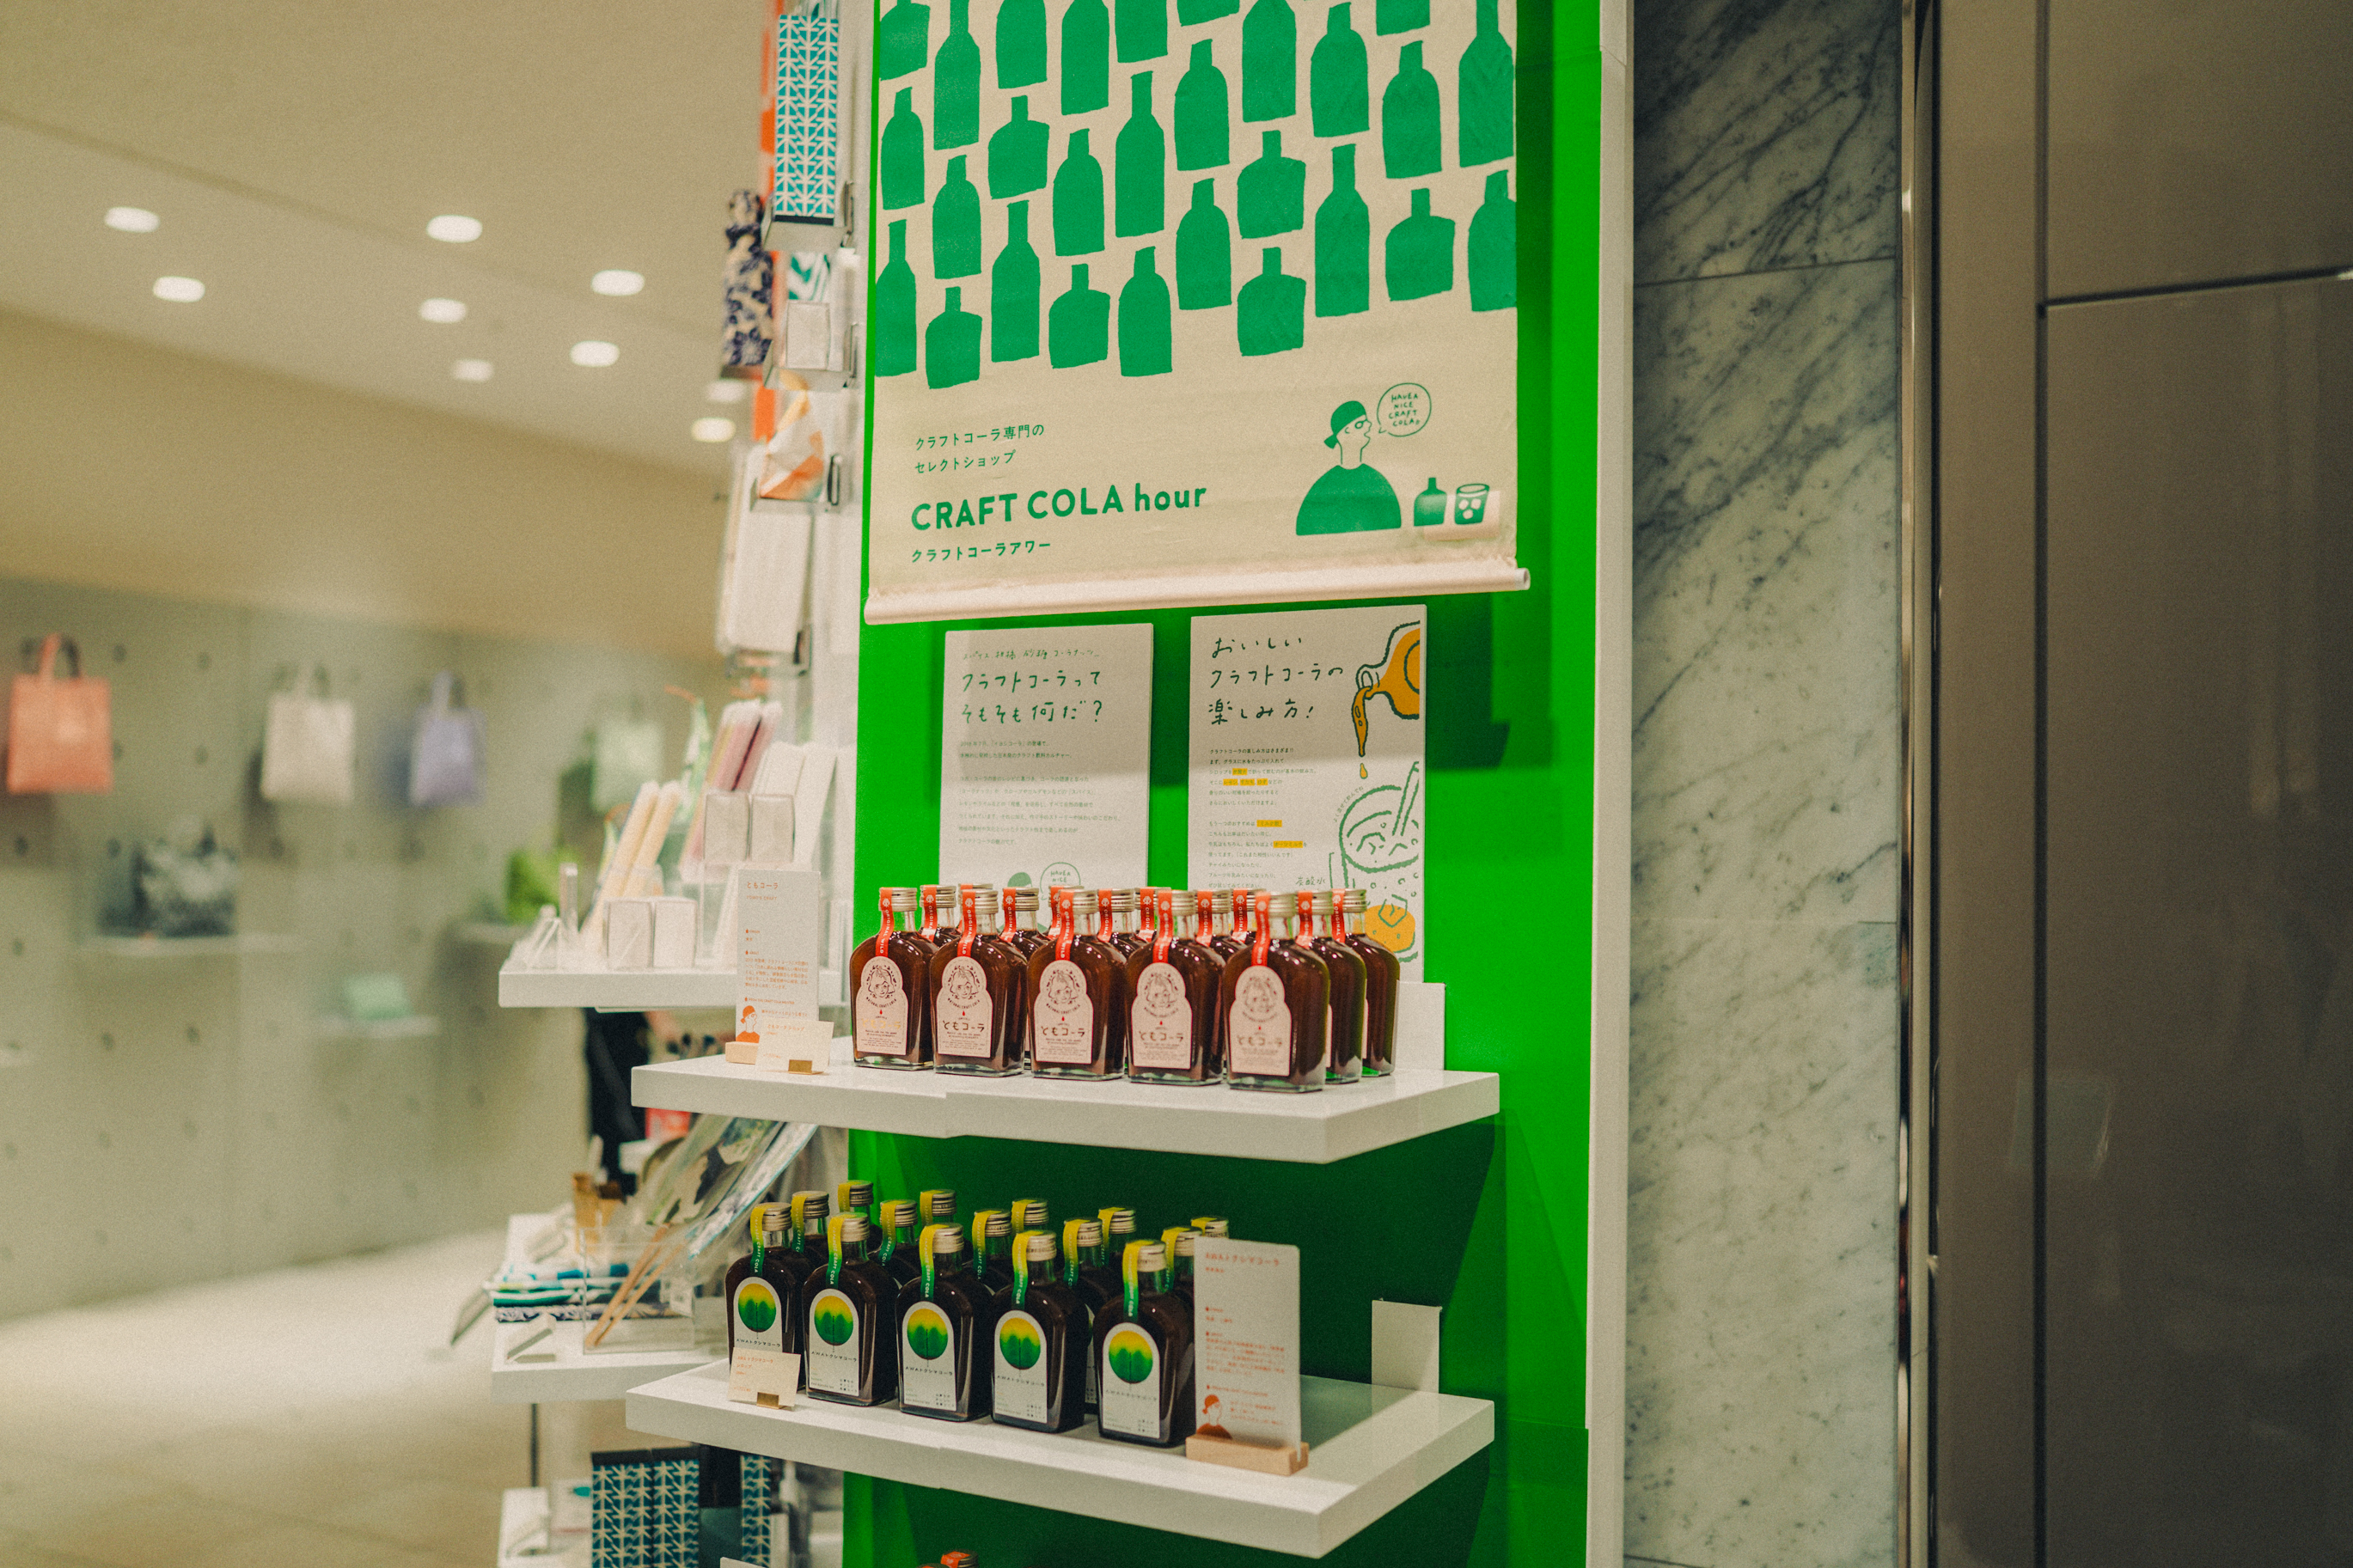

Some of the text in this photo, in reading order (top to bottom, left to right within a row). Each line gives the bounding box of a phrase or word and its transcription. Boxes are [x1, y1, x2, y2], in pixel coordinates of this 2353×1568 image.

[1389, 410, 1417, 419] CRAFT
[915, 424, 1044, 451] クラフトコーラ専門の
[915, 448, 1017, 473] セレクトショップ
[911, 482, 1207, 530] CRAFT COLA hour
[912, 540, 1051, 563] クラフトコーラアワー
[1212, 638, 1301, 658] おいしい
[963, 670, 1101, 693] クラフトコーラって
[1210, 663, 1343, 688] クラフトコーラの
[747, 882, 779, 890] ともコーラ
[1295, 876, 1326, 886] 炭酸水
[879, 909, 891, 955] ORIGINAL WILD
[962, 938, 970, 955] WILD
[861, 1018, 901, 1030] ともコーラ
[943, 1020, 985, 1033] ともコーラ
[1041, 1026, 1085, 1037] ともコーラ
[1139, 1031, 1183, 1042] ともコーラ
[736, 1338, 781, 1347] AWAトクシマコーラ
[811, 1351, 858, 1362] AWAトクシマコーラ
